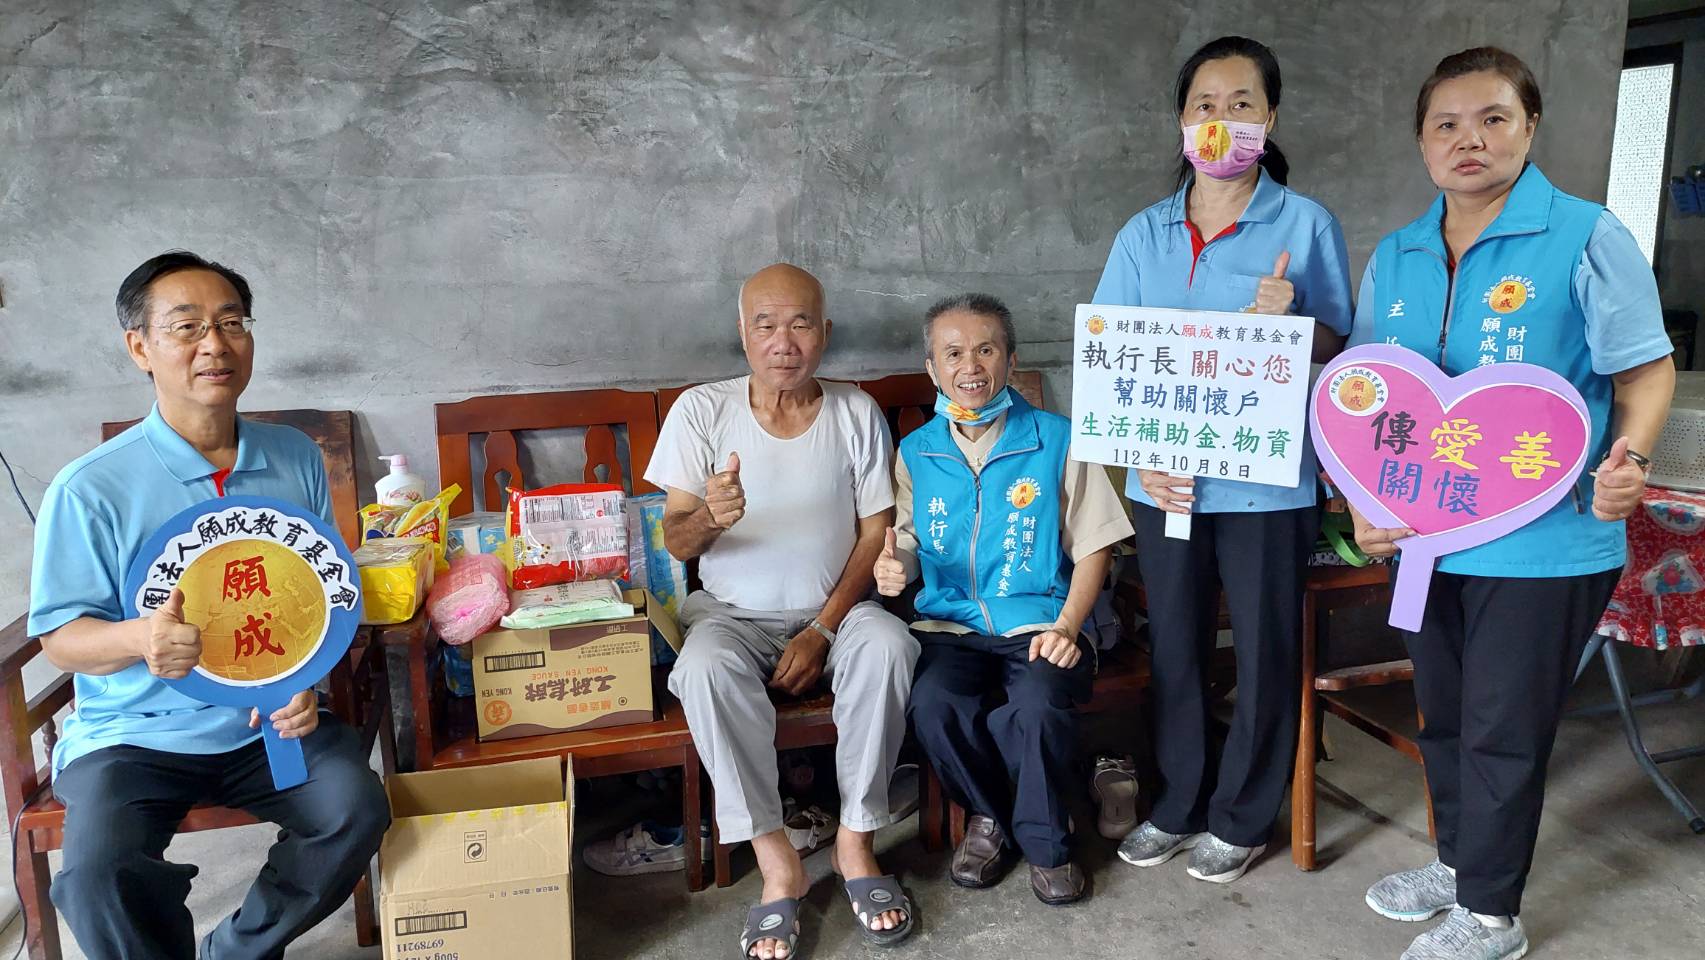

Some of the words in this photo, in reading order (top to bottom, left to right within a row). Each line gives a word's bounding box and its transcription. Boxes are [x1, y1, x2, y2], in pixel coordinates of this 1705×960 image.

[1116, 320, 1304, 346] 財團法人願成教育基金會
[1506, 326, 1528, 361] 財團
[1082, 340, 1178, 376] 執行長
[1191, 350, 1292, 384] 關心您
[1113, 376, 1260, 417] 幫助關懷戶
[1378, 458, 1480, 516] 關懷
[928, 497, 948, 554] 執行長
[1016, 516, 1036, 572] 財團法人
[222, 555, 285, 662] 願成
[532, 671, 560, 680] SAUCE
[566, 669, 582, 678] YEN
[587, 666, 608, 674] KONG
[482, 689, 494, 698] YEN
[496, 688, 512, 696] KONG
[397, 938, 444, 952] 69789211
